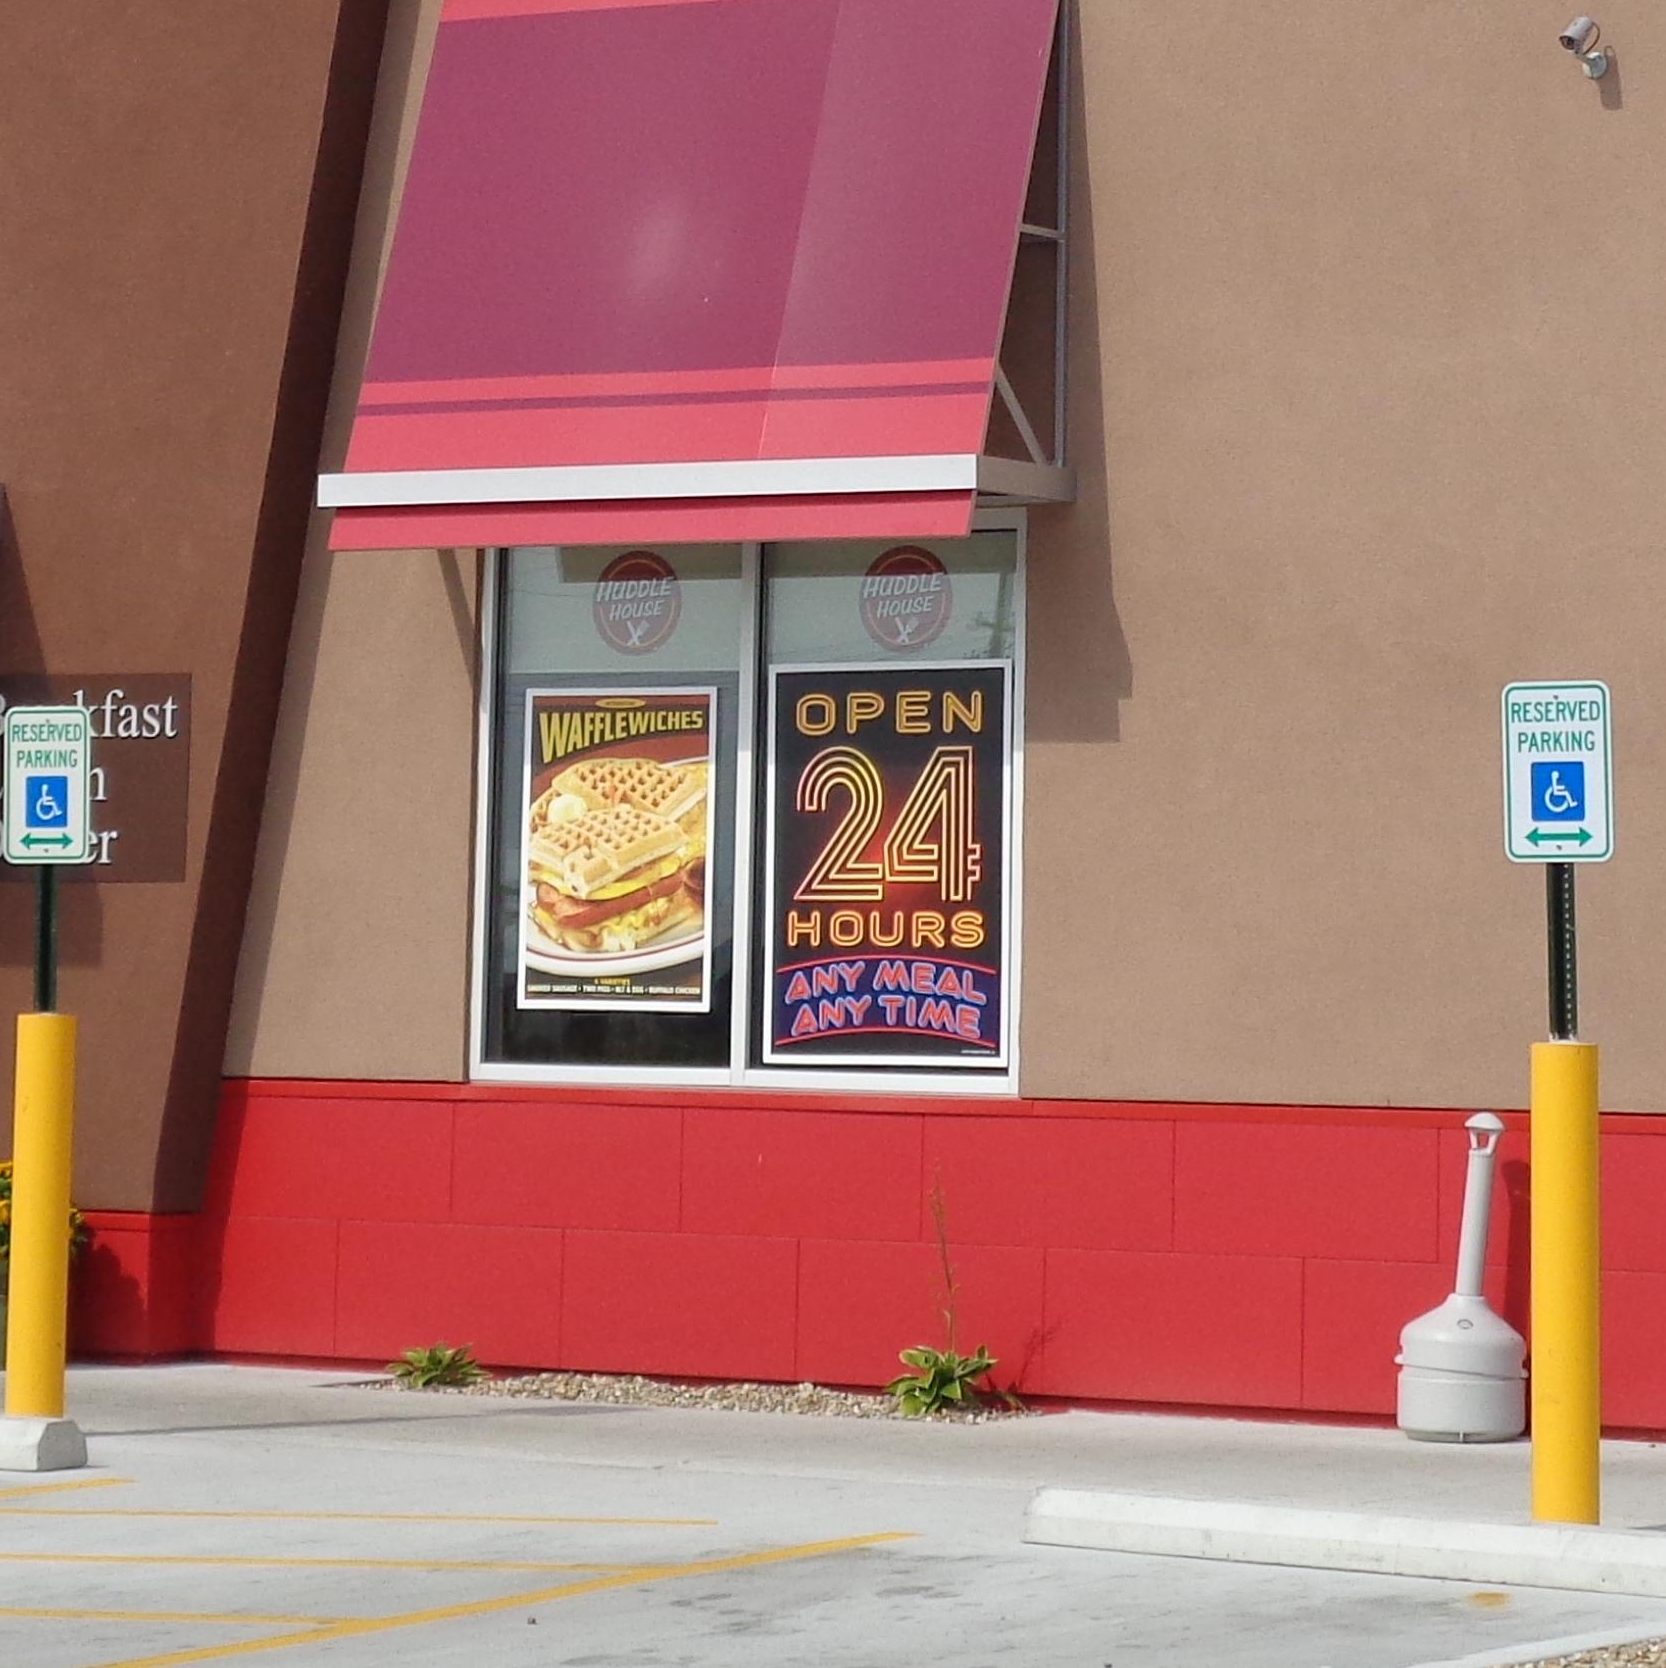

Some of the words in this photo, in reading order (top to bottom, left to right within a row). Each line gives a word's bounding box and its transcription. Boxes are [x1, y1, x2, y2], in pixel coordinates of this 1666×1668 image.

[596, 577, 674, 602] HUDDLE
[863, 572, 944, 599] HUDDLE
[609, 599, 665, 620] HOUSE
[877, 596, 934, 618] HOUSE
[795, 689, 983, 736] OPEN
[1511, 701, 1600, 723] RESERVED
[12, 723, 82, 742] RESERVED
[539, 710, 703, 764] WAFFLEWICHES
[1517, 730, 1595, 753] PARKING
[16, 749, 77, 768] PARKING
[794, 745, 982, 902] 24
[787, 910, 984, 948] HOURS
[785, 961, 865, 1004] ANY
[873, 960, 986, 1005] MEAL
[791, 995, 871, 1037] ANY
[878, 996, 981, 1038] TIME
